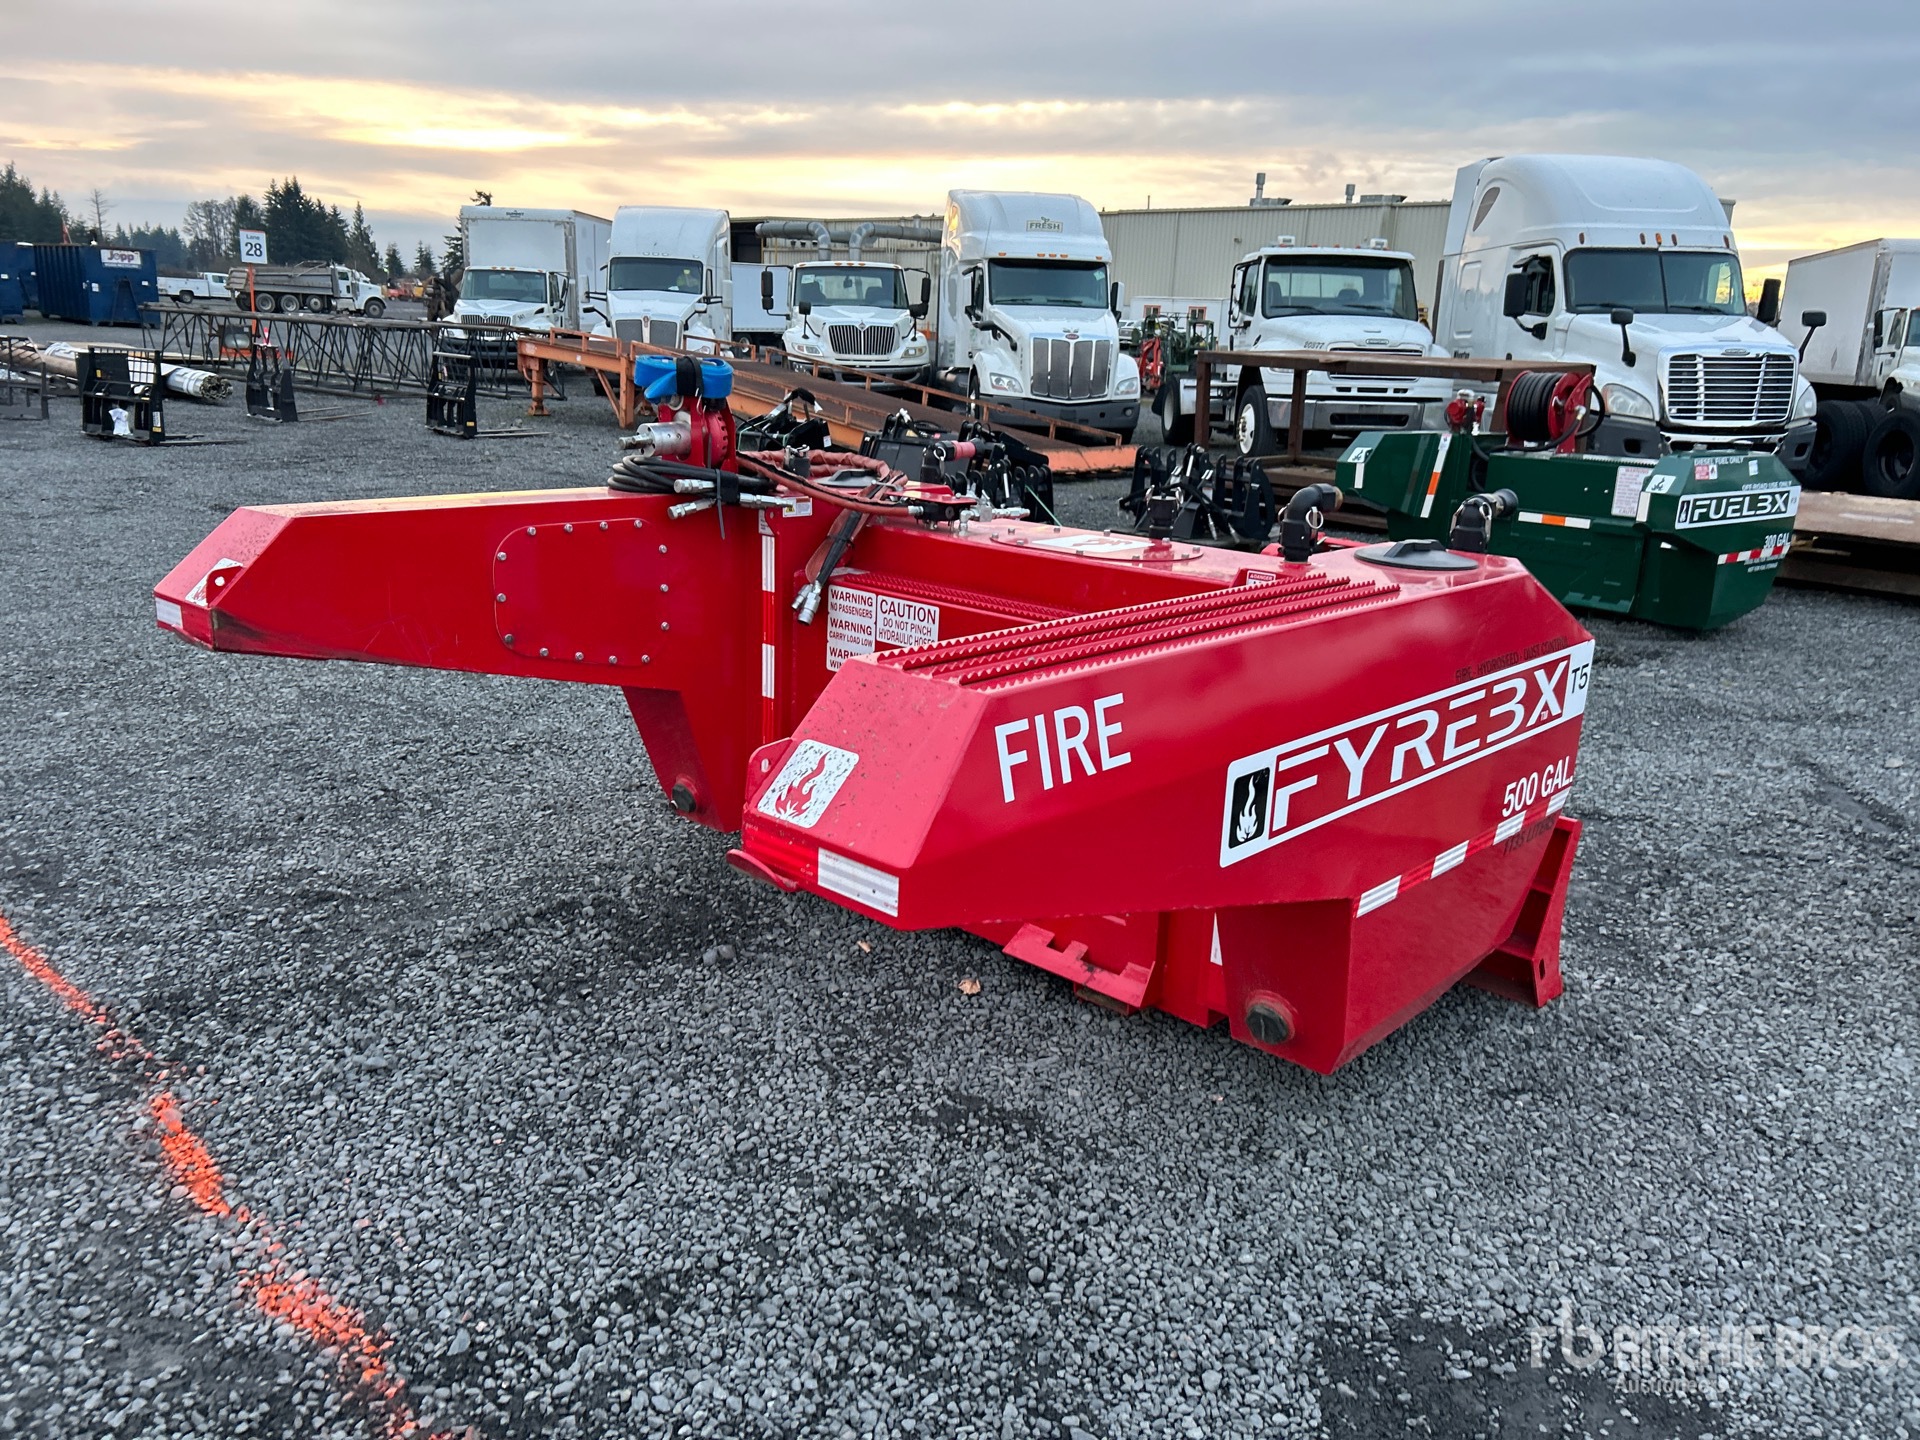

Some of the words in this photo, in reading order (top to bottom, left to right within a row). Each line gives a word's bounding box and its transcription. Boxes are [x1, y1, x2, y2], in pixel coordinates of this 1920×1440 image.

[1029, 222, 1060, 230] FRESH
[244, 241, 263, 257] 28
[1694, 457, 1714, 466] DIESEL
[1715, 456, 1729, 465] FUEL
[1729, 456, 1744, 464] ONLY
[1778, 480, 1792, 488] ONLY
[1763, 534, 1778, 549] 300
[831, 588, 873, 607] WARNING
[830, 601, 838, 612] NO
[838, 603, 873, 619] PASSENGERS
[880, 599, 937, 625] CAUTION
[830, 617, 872, 636] WARNING
[883, 617, 894, 629] DO
[895, 619, 909, 632] NOT
[910, 623, 932, 637] PINCH
[829, 630, 846, 641] CARRY
[846, 633, 861, 644] LOAD
[861, 639, 873, 648] LOW
[878, 627, 914, 646] HYDRAULIC
[1477, 652, 1519, 675] HYDROSEED
[1523, 644, 1540, 660] DUST
[1571, 663, 1590, 694] T5
[994, 692, 1132, 804] FIRE
[1502, 771, 1539, 818] 500
